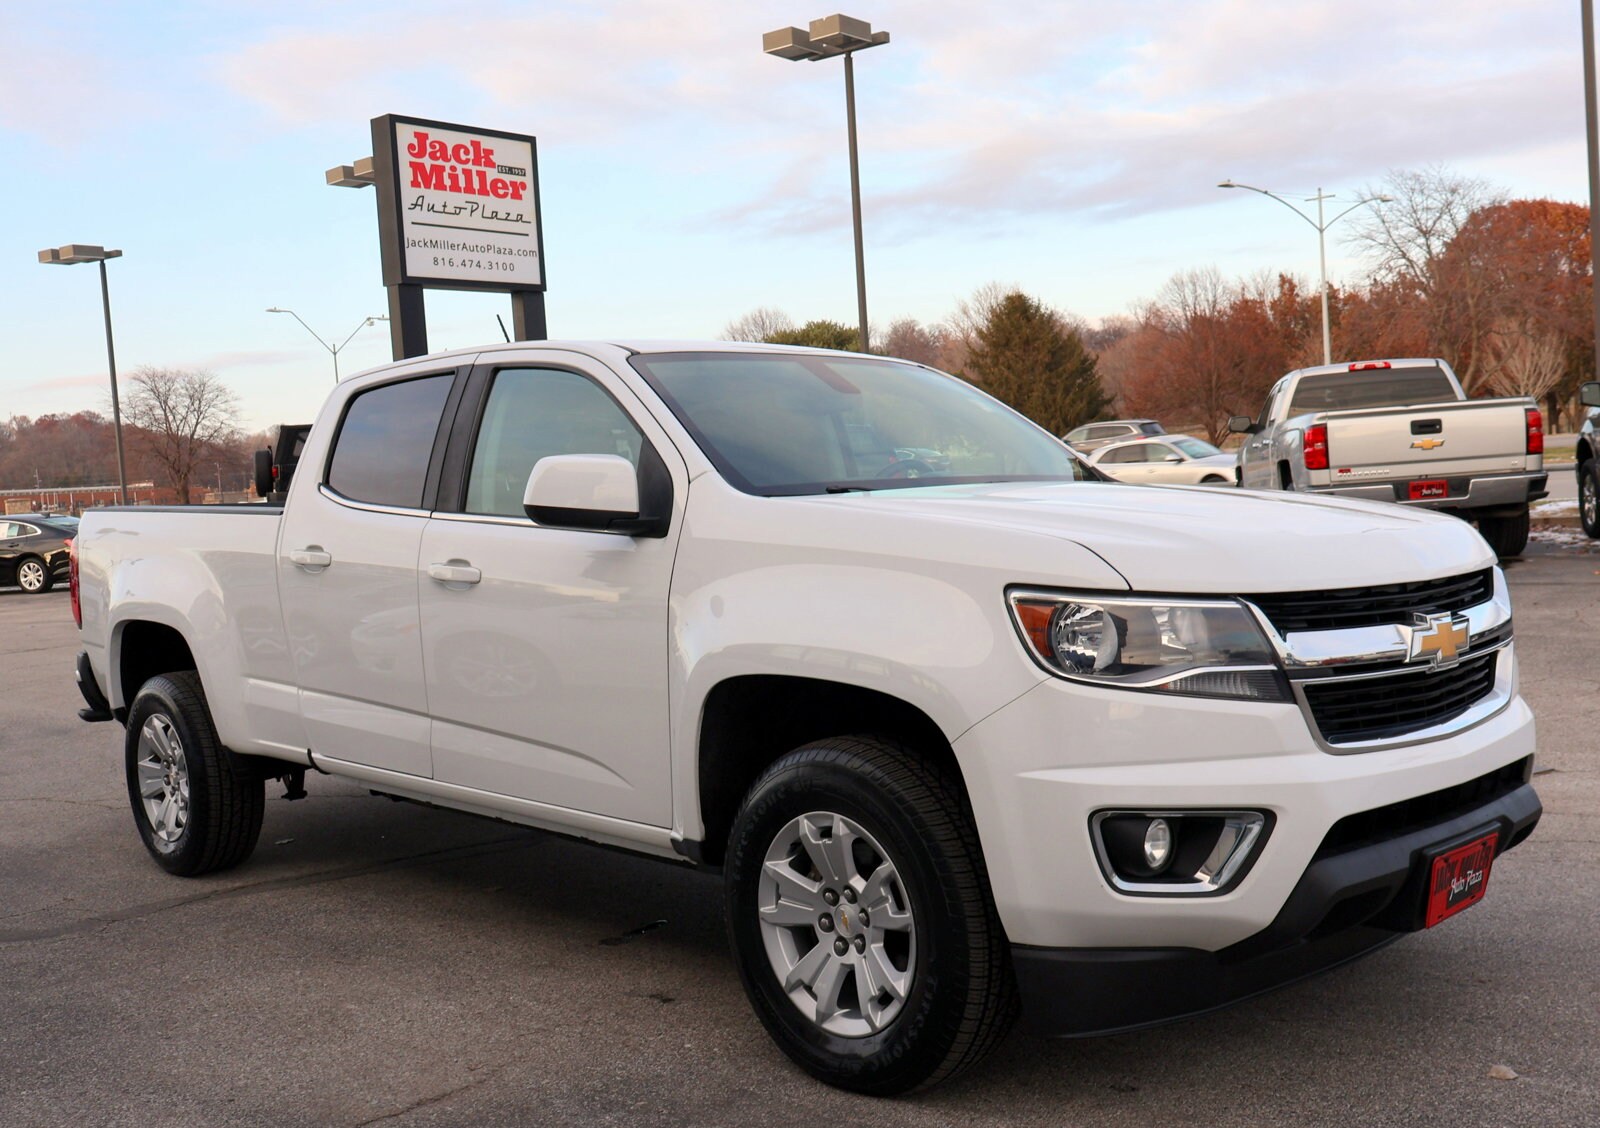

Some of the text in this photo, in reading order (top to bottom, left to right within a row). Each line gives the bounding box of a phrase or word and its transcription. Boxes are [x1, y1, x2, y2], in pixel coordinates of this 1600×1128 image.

[407, 131, 496, 168] Jack
[409, 161, 527, 200] Miller
[406, 237, 537, 258] JackMillerAutoPlaza.com
[433, 257, 515, 271] 816.474.3100
